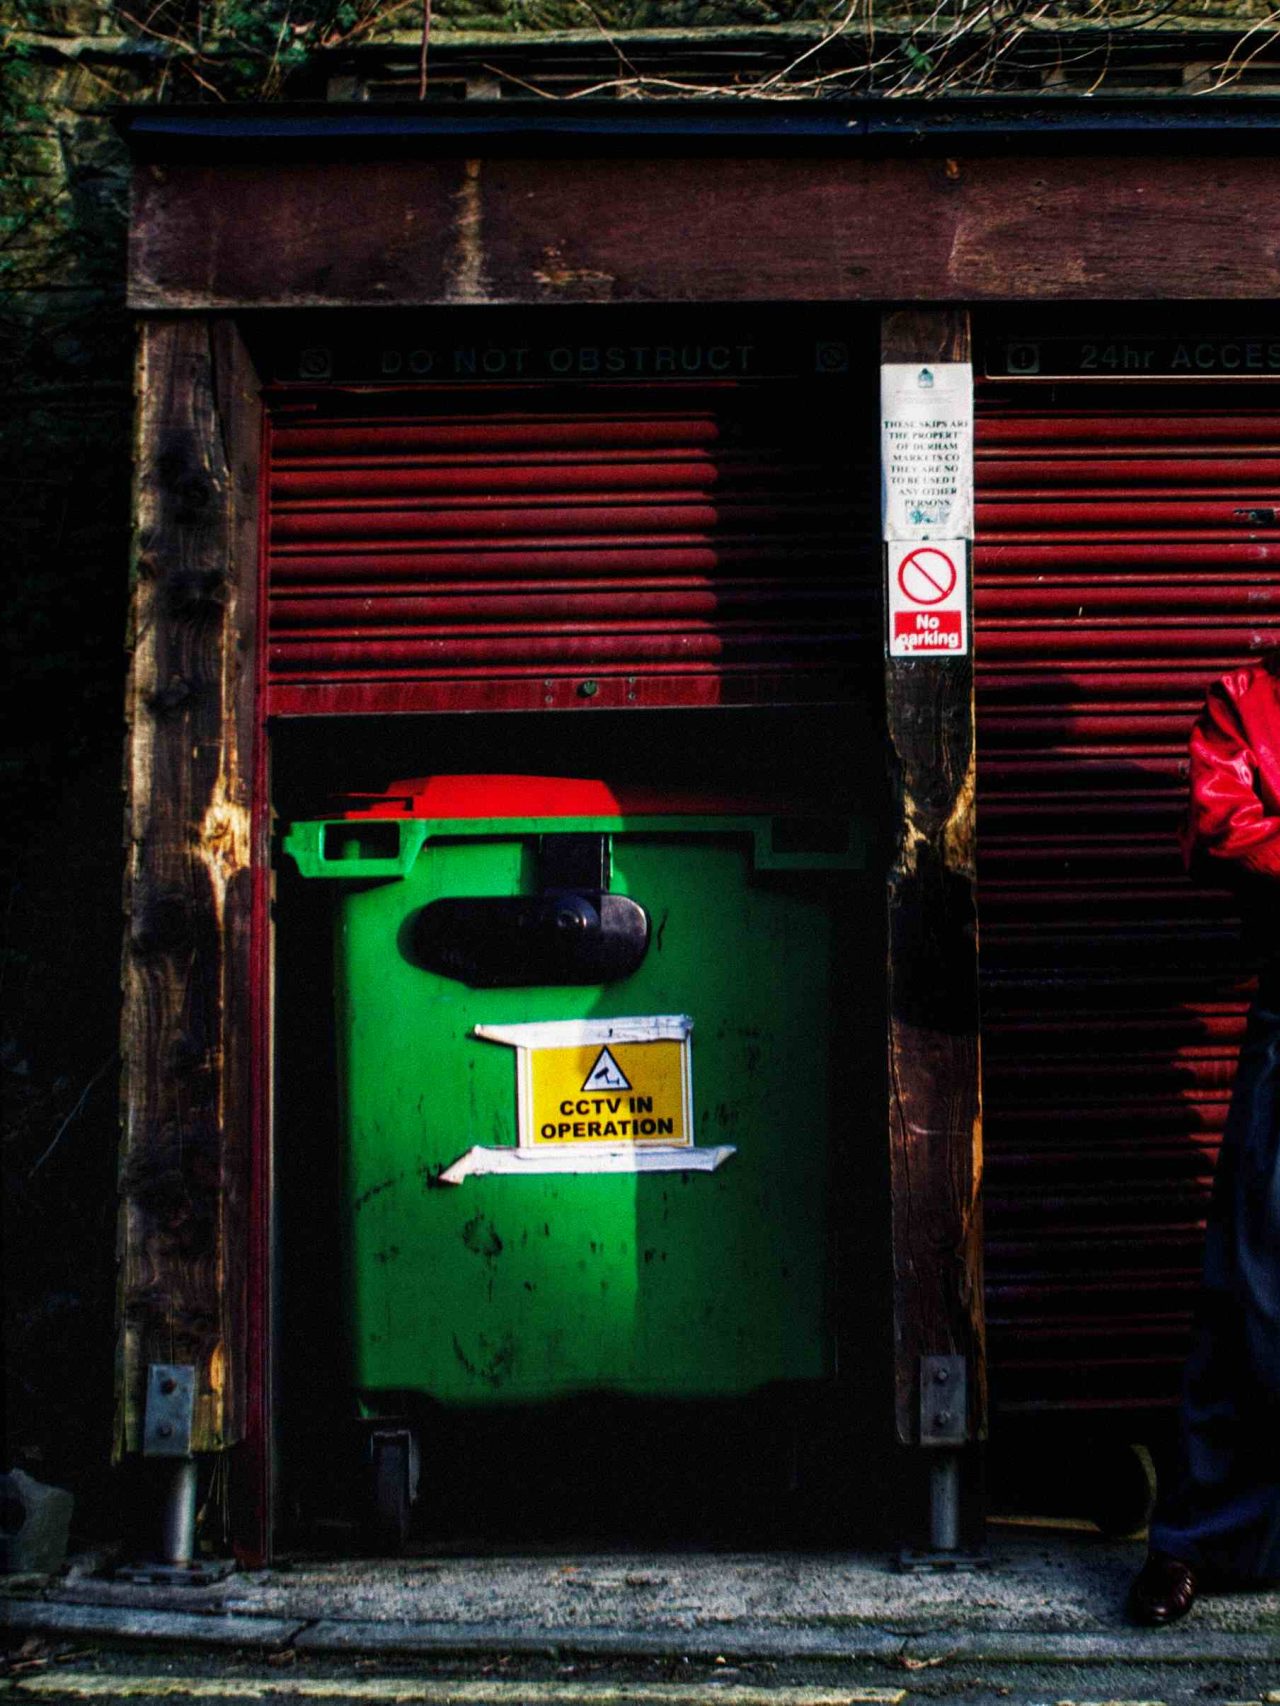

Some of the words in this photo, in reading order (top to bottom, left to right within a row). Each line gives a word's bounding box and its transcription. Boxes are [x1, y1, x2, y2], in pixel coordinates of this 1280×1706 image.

[379, 350, 434, 374] DO
[449, 348, 532, 373] NOT
[547, 345, 751, 372] OBSTRUCT
[1082, 344, 1154, 369] 24hr
[920, 420, 948, 428] SKIPS
[889, 432, 907, 440] THE
[912, 431, 961, 439] PROPERT
[922, 487, 957, 495] OTHER
[916, 613, 940, 631] No
[898, 629, 960, 650] parking
[560, 1097, 621, 1116] CCTV
[629, 1096, 653, 1113] IN
[541, 1117, 674, 1139] OPERATION
